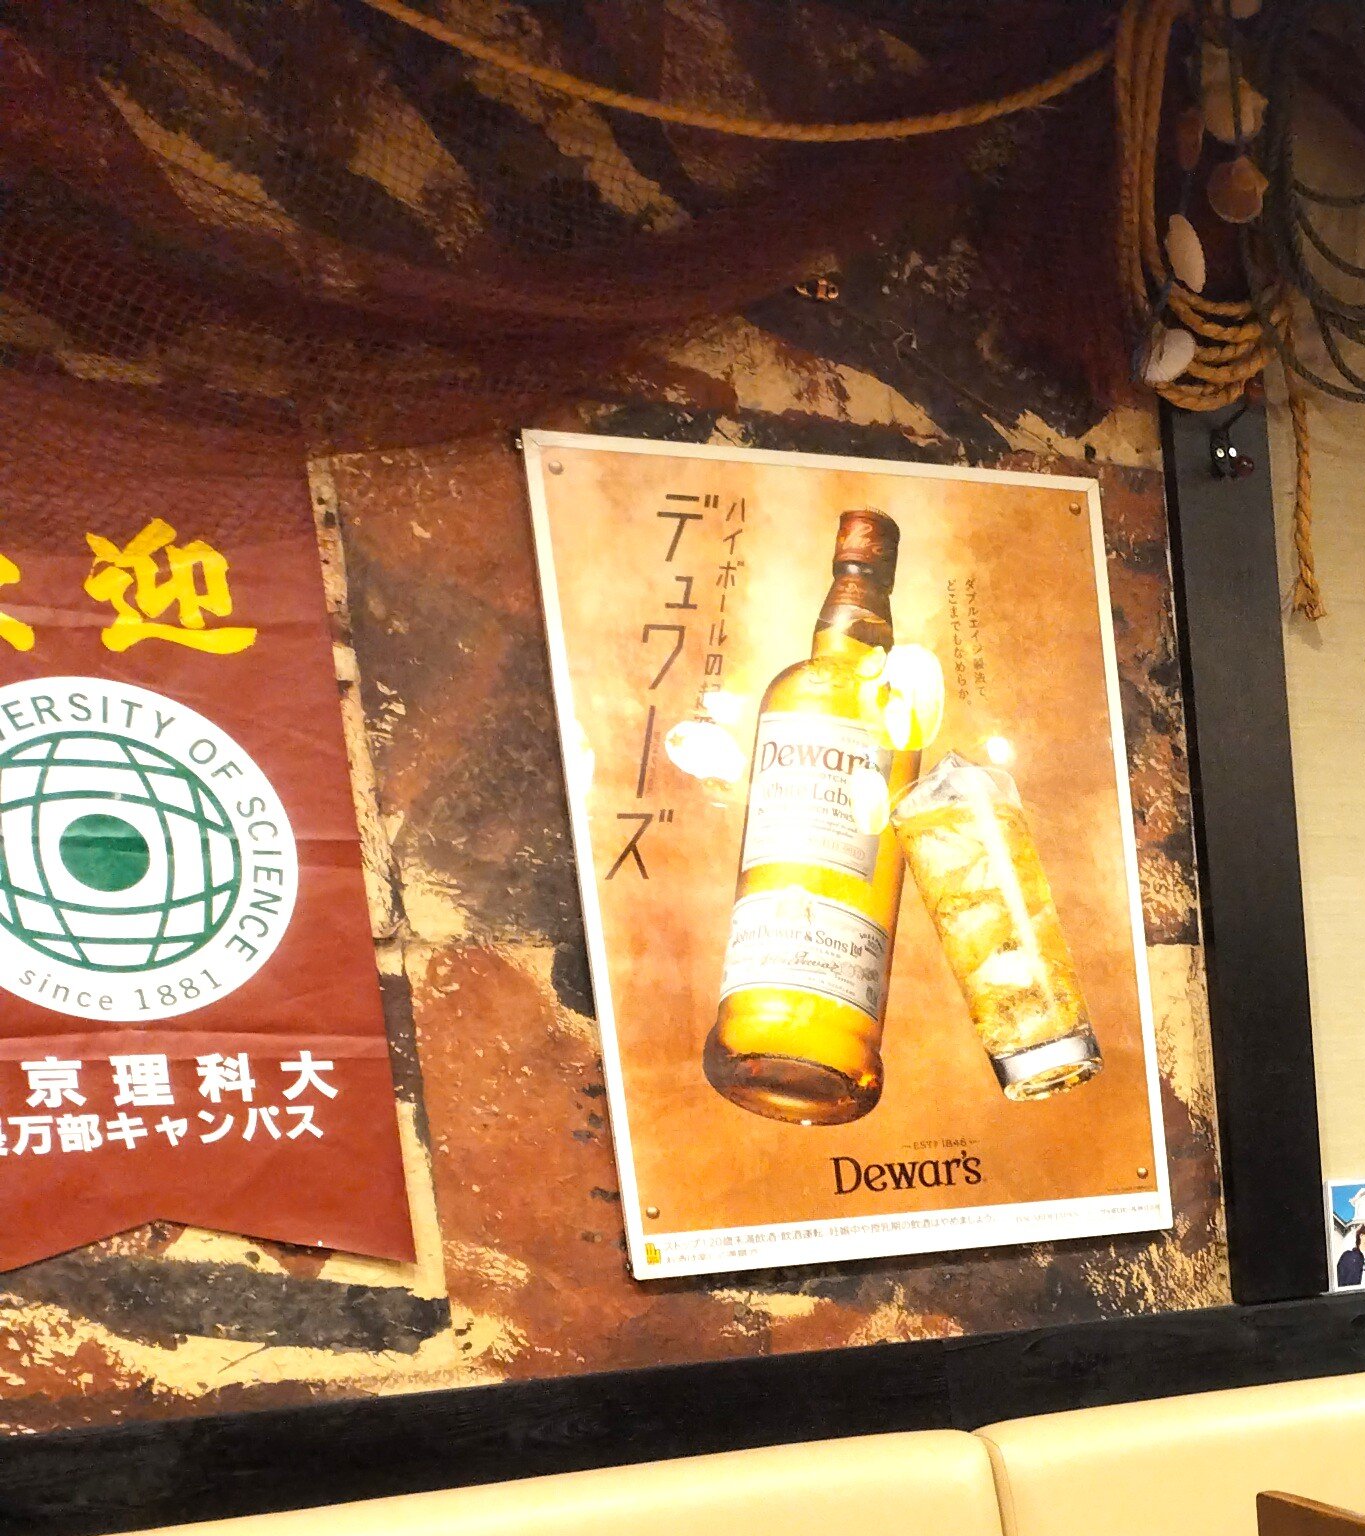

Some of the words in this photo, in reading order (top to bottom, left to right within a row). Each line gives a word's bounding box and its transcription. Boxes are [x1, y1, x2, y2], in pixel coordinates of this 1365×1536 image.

[693, 497, 746, 724] ハイボールの
[605, 493, 719, 880] デュワーズ
[0, 692, 176, 741] ERSITY
[188, 738, 243, 779] OF
[225, 796, 283, 962] SCIENCE
[18, 968, 114, 1011] since
[134, 968, 223, 1011] 1881
[815, 930, 848, 953] Sons
[829, 1150, 982, 1195] Dewar's
